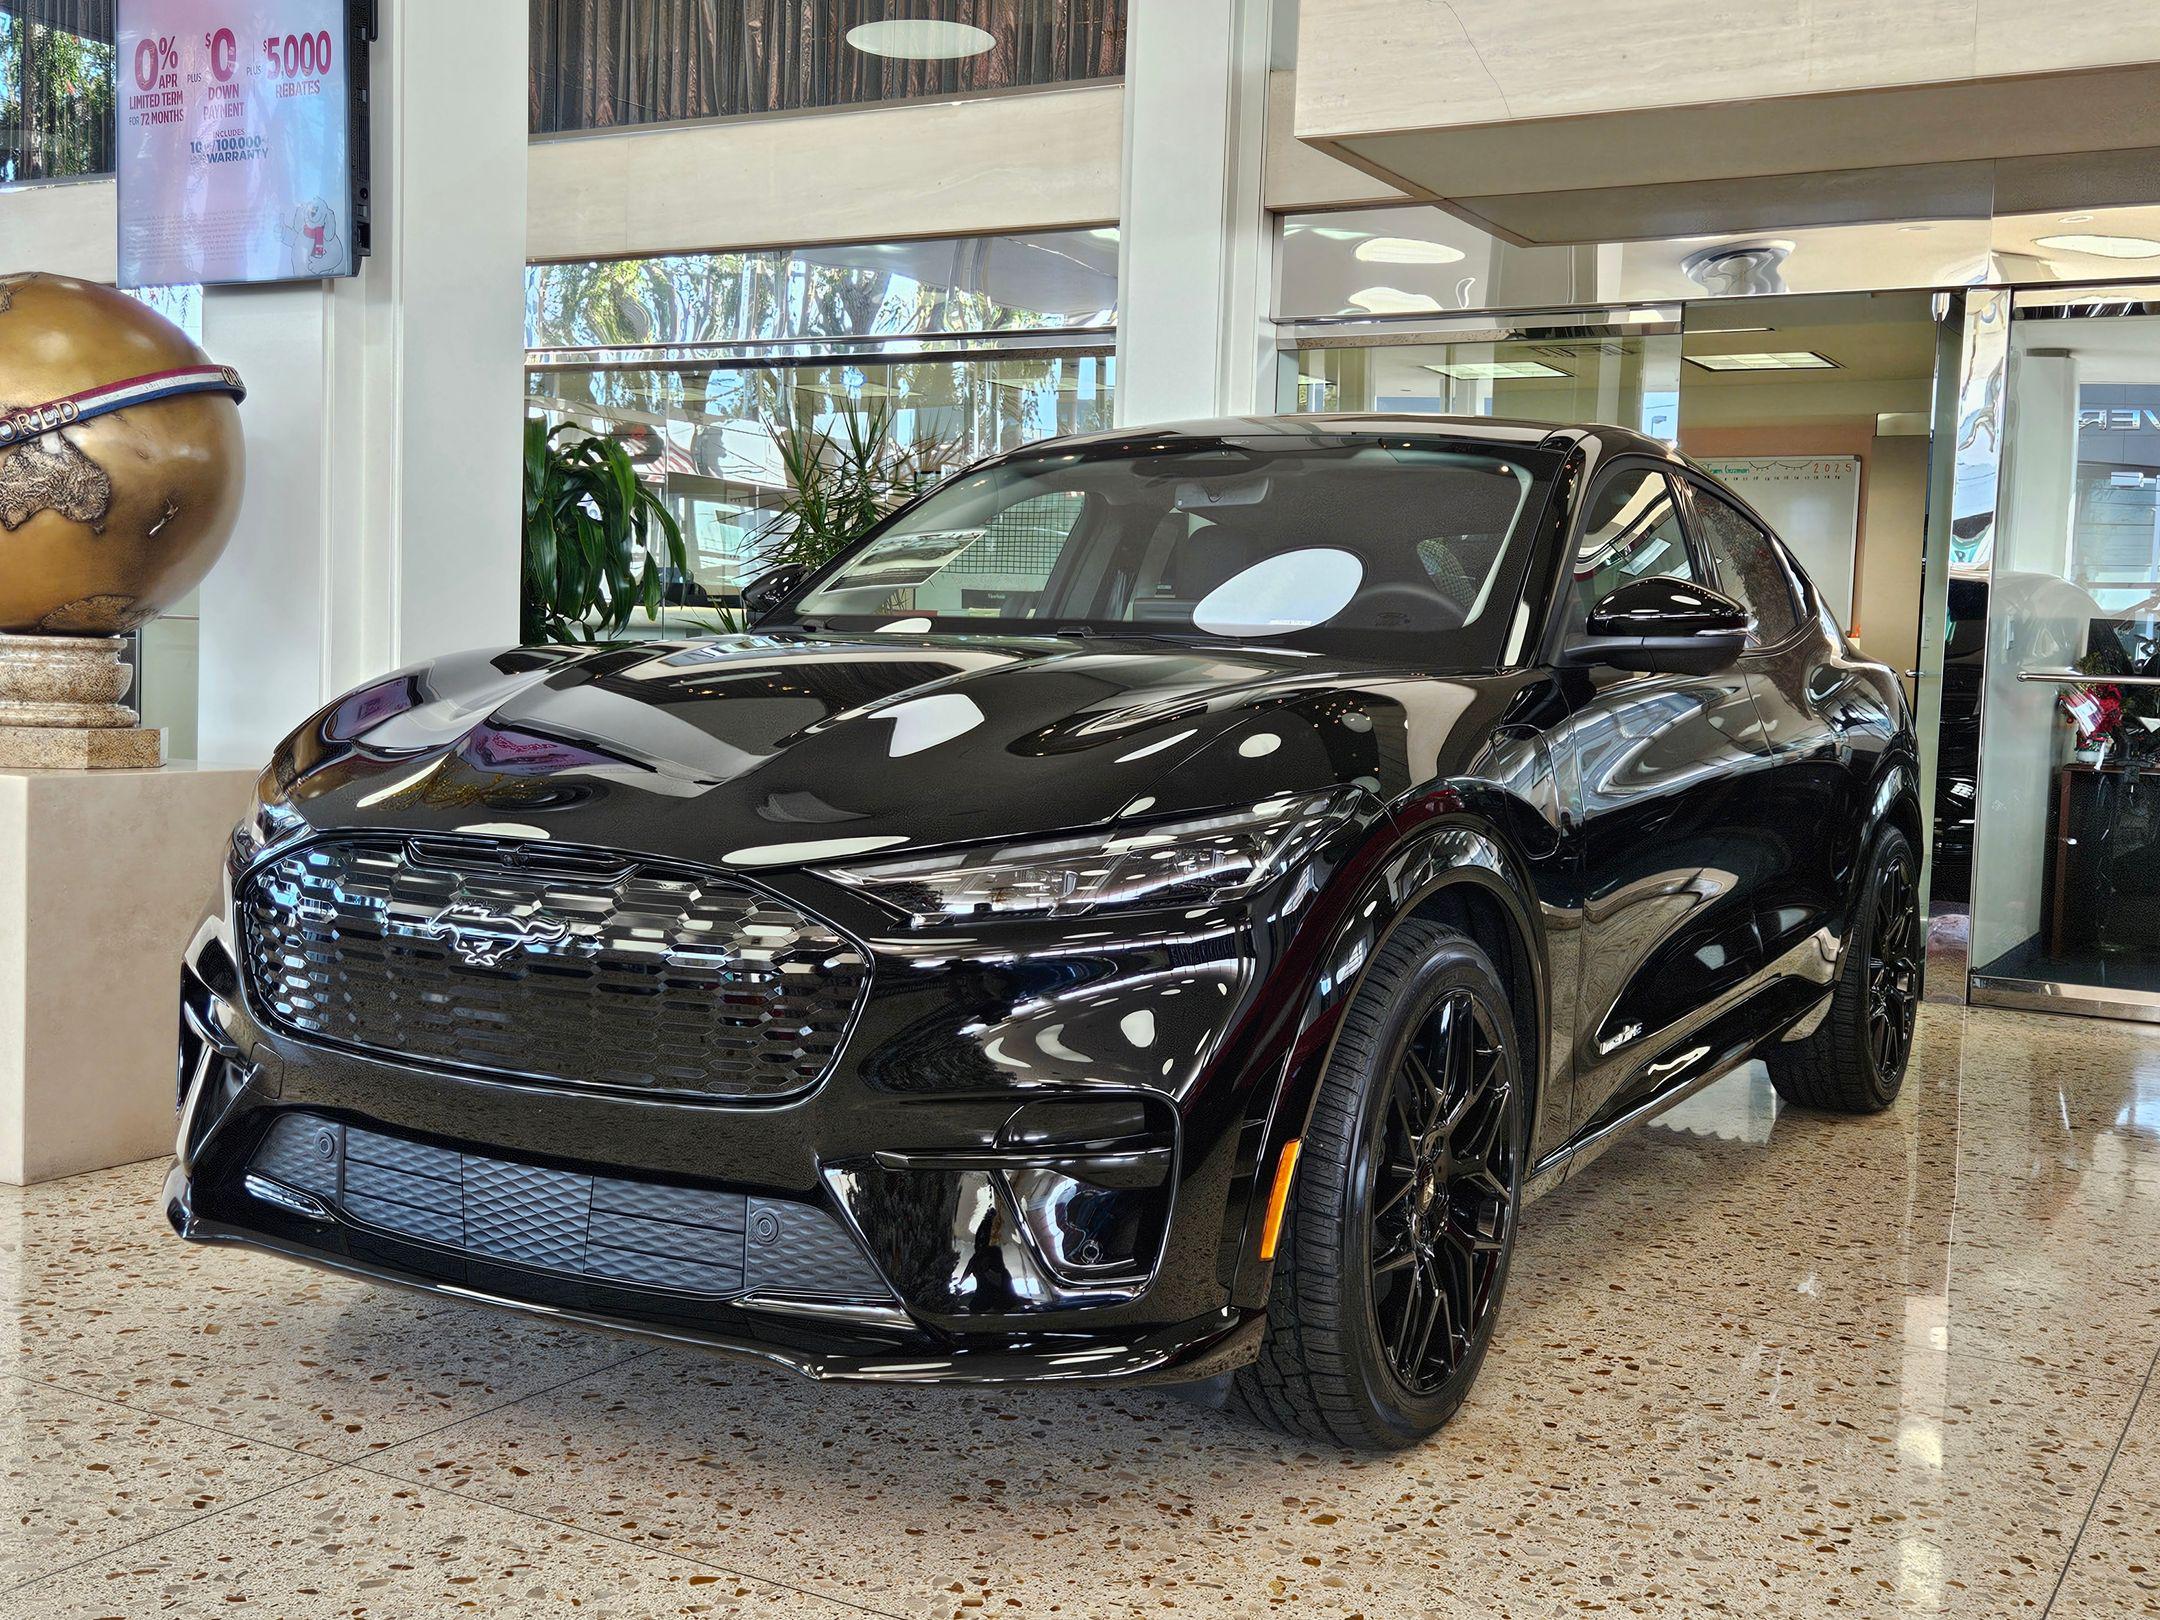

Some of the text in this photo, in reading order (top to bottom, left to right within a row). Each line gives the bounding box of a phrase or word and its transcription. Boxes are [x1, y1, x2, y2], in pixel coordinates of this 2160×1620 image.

[134, 35, 179, 92] 0%
[205, 27, 237, 82] $0
[187, 73, 202, 83] PLUS
[247, 65, 262, 76] PLUS
[159, 73, 178, 89] APR
[275, 80, 320, 98] REBATES
[129, 90, 184, 110] LIMITED TERM
[208, 84, 240, 100] DOWN
[129, 108, 185, 126] FOR 72 MONTHS
[203, 102, 244, 121] PAYMENT
[206, 147, 269, 164] WARRANTY
